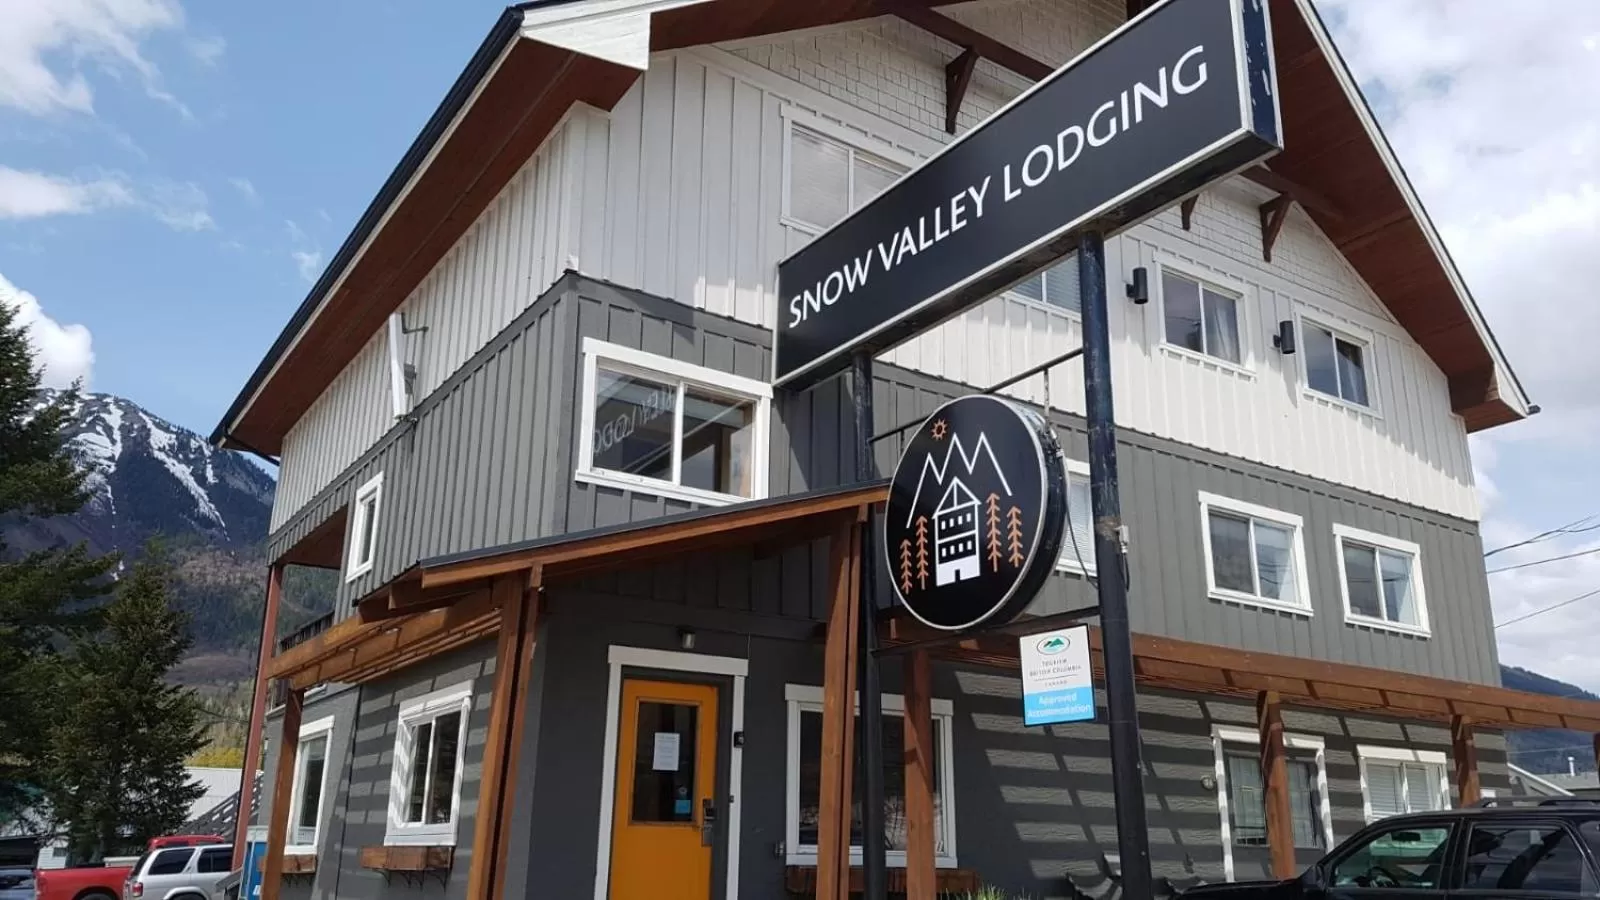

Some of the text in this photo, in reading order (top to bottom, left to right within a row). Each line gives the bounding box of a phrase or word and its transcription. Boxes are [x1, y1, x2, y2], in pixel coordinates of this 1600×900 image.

[788, 44, 1208, 329] SNOW VALLEY LODGING
[1052, 665, 1082, 674] COLUMBIA
[1039, 693, 1077, 705] Approved
